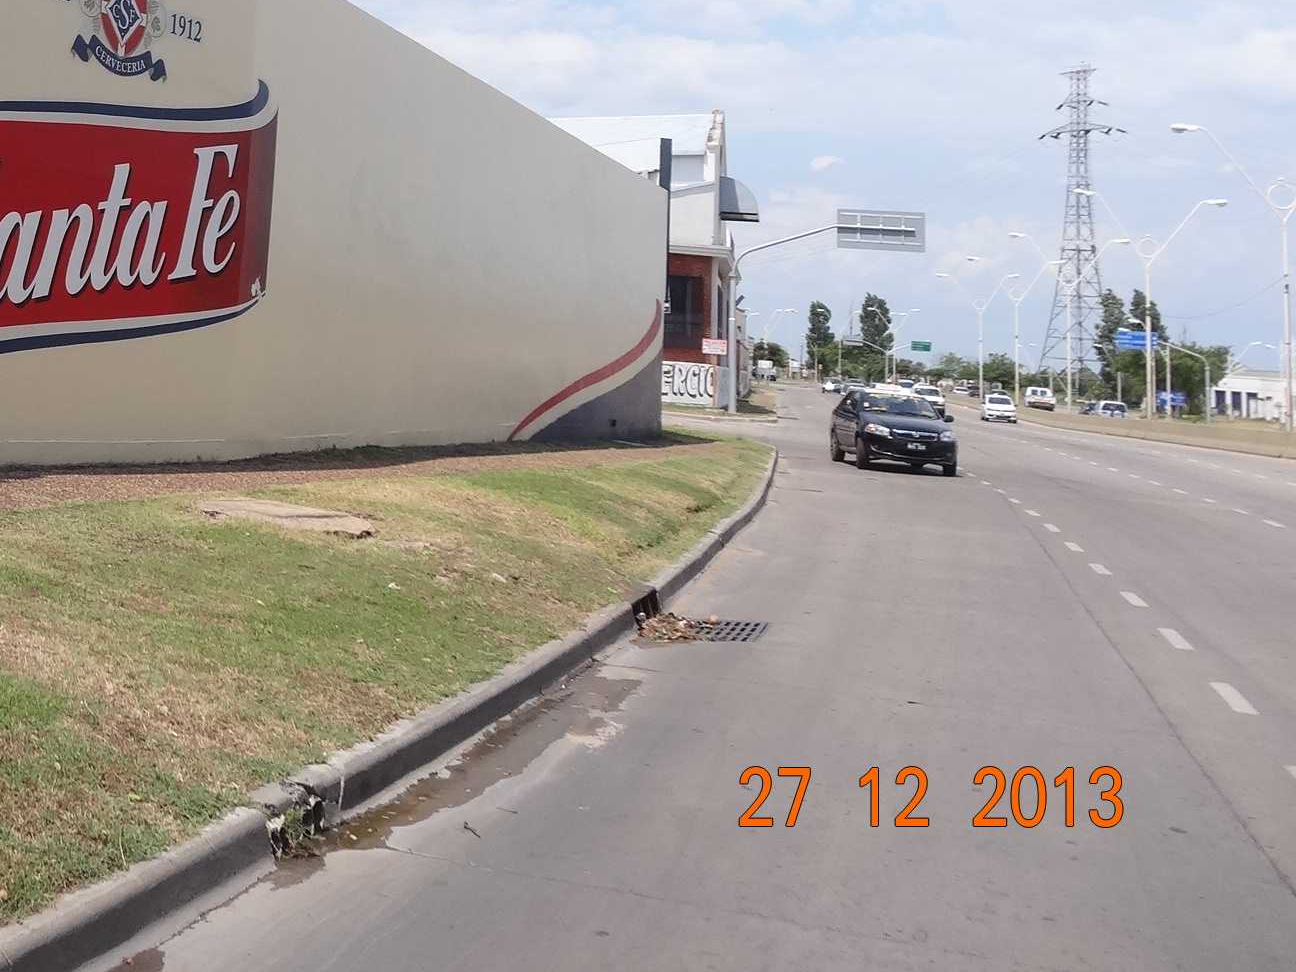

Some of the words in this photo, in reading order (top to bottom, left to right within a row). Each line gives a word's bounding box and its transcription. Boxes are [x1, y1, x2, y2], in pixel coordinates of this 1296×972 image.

[170, 13, 203, 42] 1912
[95, 45, 146, 74] CERVECERIA
[168, 143, 241, 282] Fe
